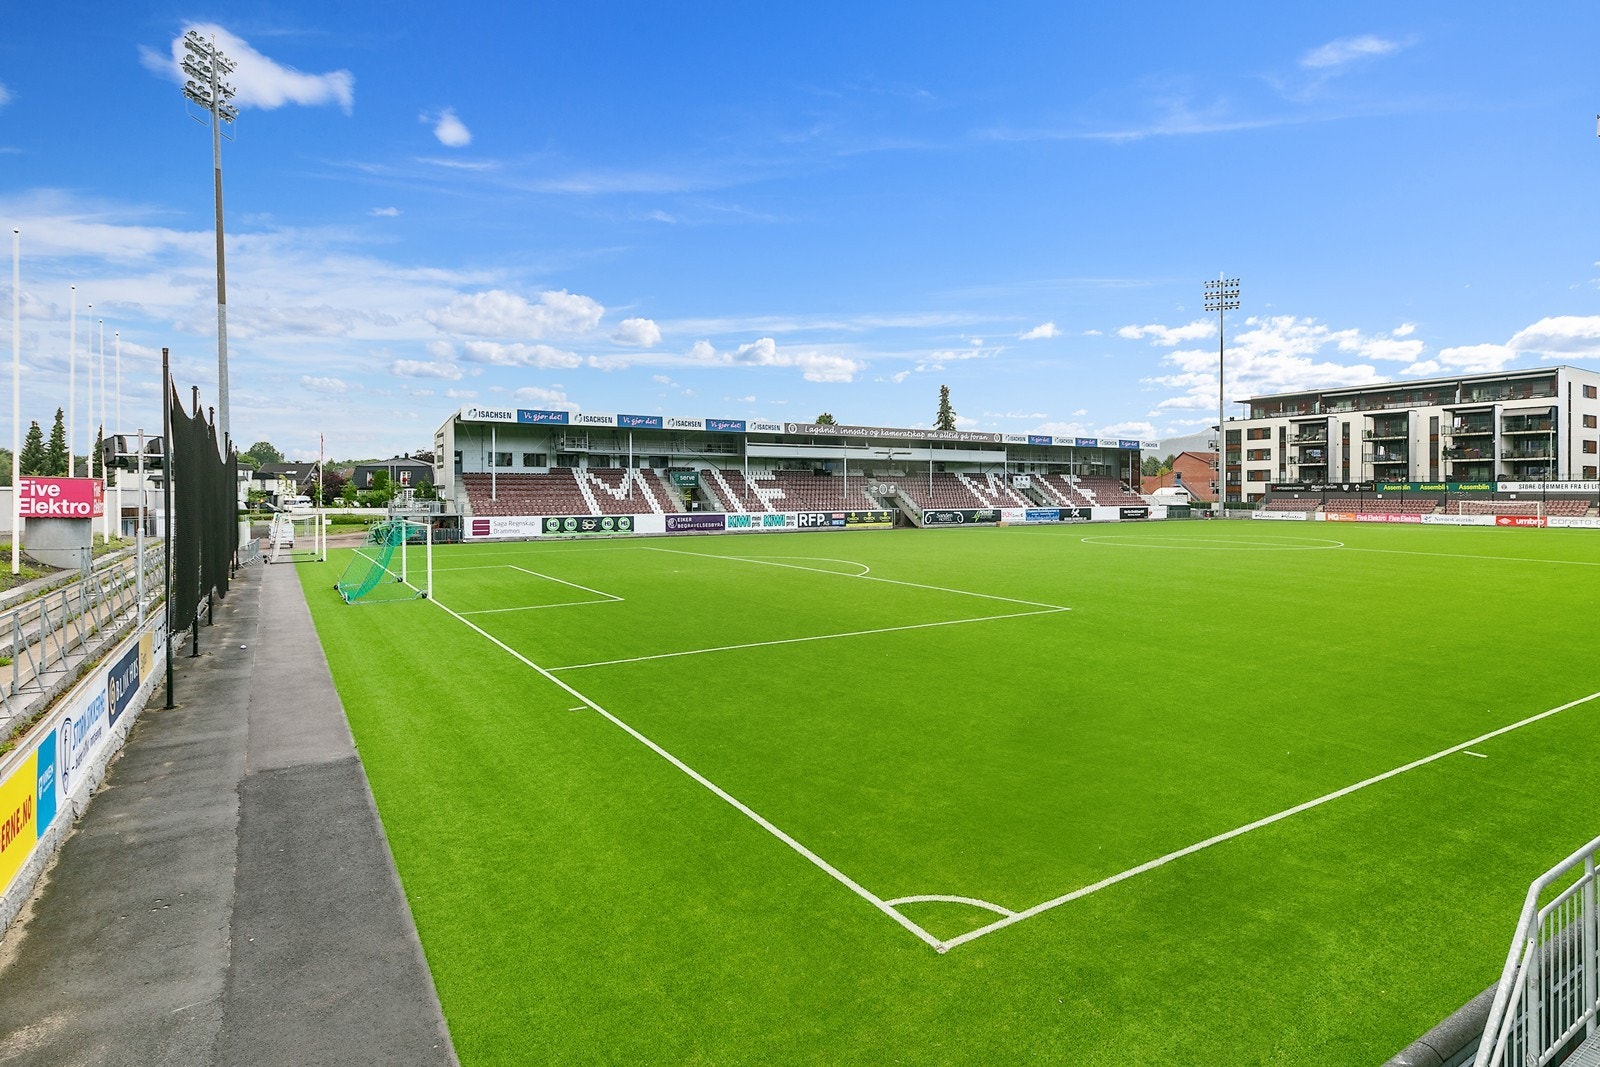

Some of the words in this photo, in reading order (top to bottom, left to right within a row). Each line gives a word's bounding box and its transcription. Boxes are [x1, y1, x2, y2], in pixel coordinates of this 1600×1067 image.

[478, 411, 512, 419] ISACHSEN
[533, 413, 549, 422] gjør
[549, 413, 563, 421] det!
[583, 415, 613, 423] ISACHSEN
[631, 417, 645, 426] gjør
[675, 420, 702, 428] ISACHSEN
[718, 422, 731, 430] gjør
[757, 423, 781, 431] ISACHSEN
[840, 427, 869, 436] innsats
[881, 429, 926, 439] kameratskap
[940, 431, 960, 439] alltid
[960, 433, 970, 441] gå
[19, 480, 61, 497] Five
[19, 498, 91, 514] Elektro
[493, 519, 507, 528] Saga
[508, 519, 536, 528] Regnskap
[728, 515, 751, 528] KIWI
[763, 515, 786, 527] KIWI
[799, 514, 826, 526] RFP
[1515, 517, 1544, 525] umbro
[677, 521, 724, 529] BEGRAVELSESBYRÅ
[1, 794, 32, 853] ERNE.NO
